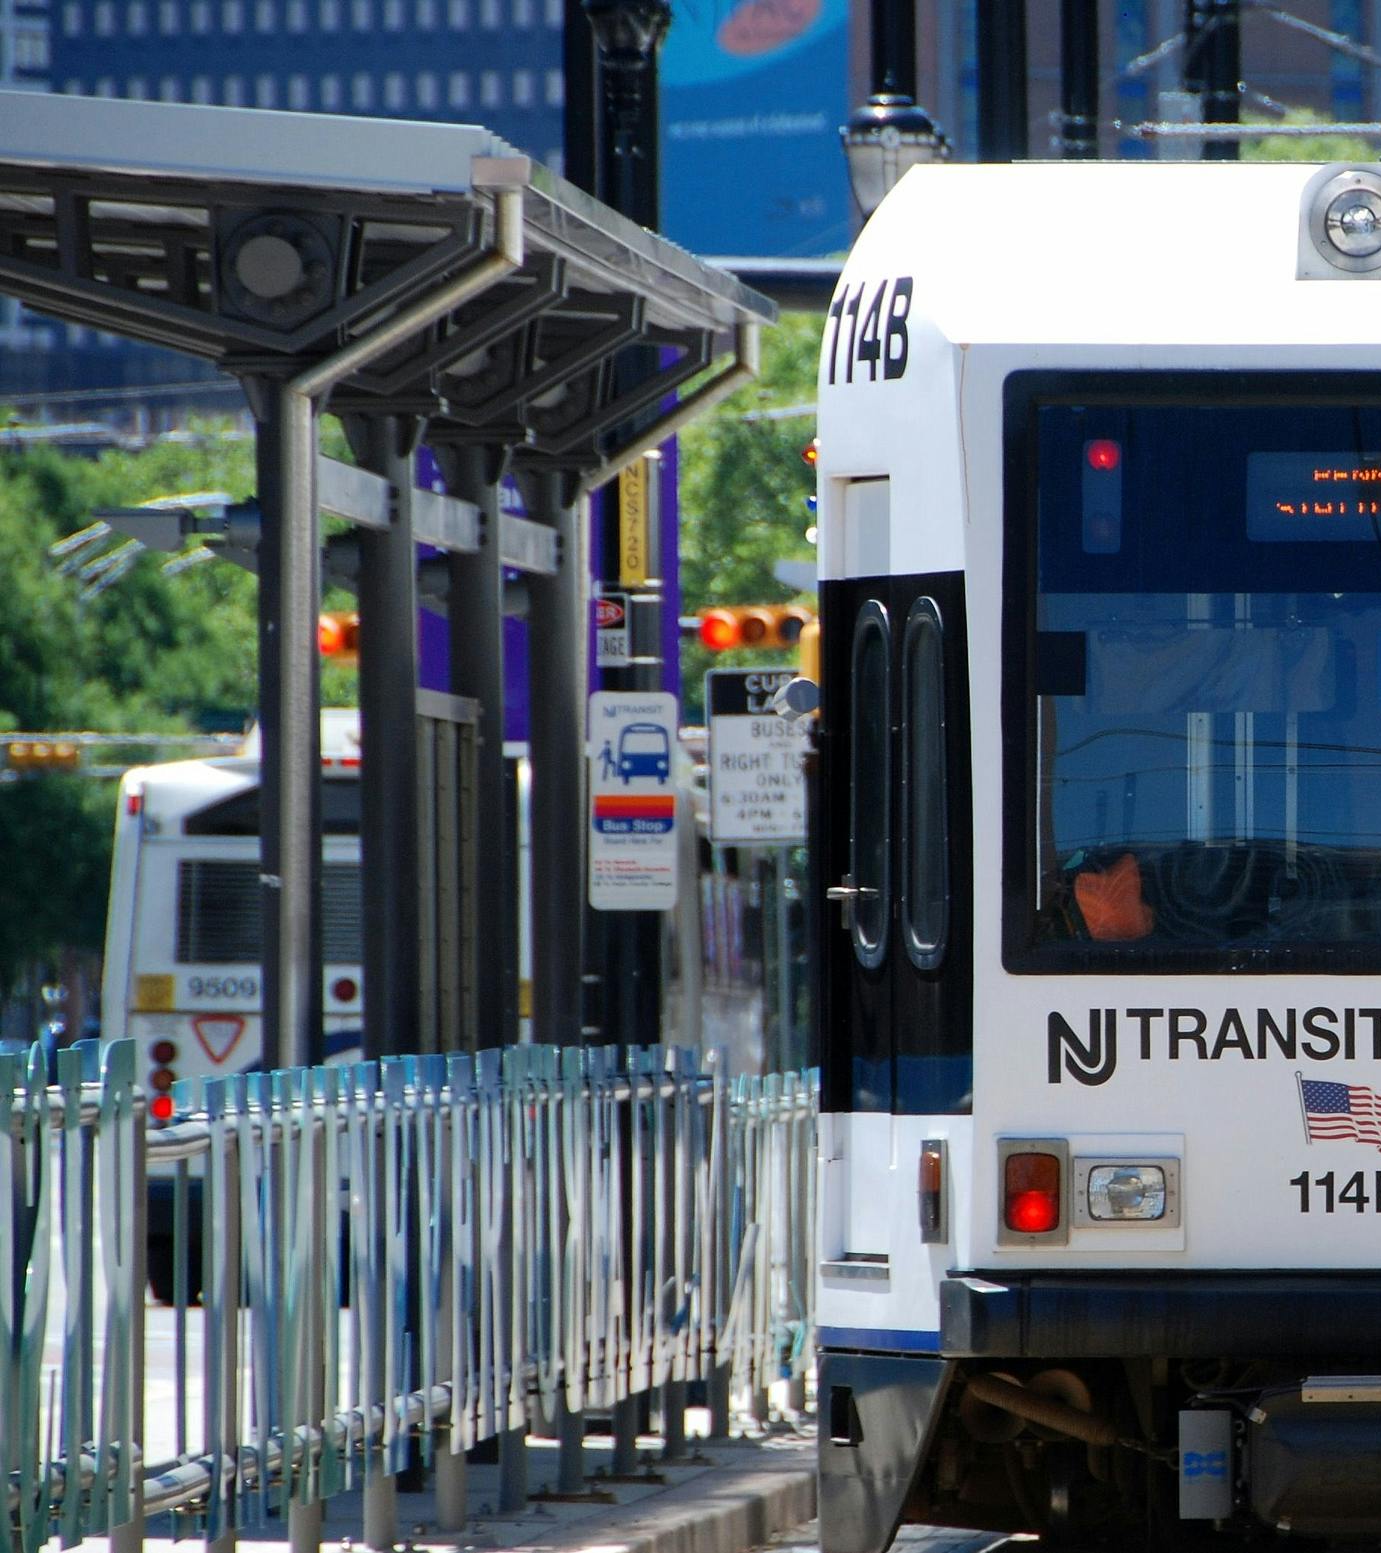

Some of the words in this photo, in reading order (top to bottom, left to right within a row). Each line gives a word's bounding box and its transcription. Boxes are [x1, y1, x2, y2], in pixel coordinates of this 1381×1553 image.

[829, 276, 913, 385] 114B
[720, 752, 770, 770] RIGHT
[602, 819, 628, 831] Bus
[632, 819, 663, 833] Stop
[188, 976, 257, 998] 9509
